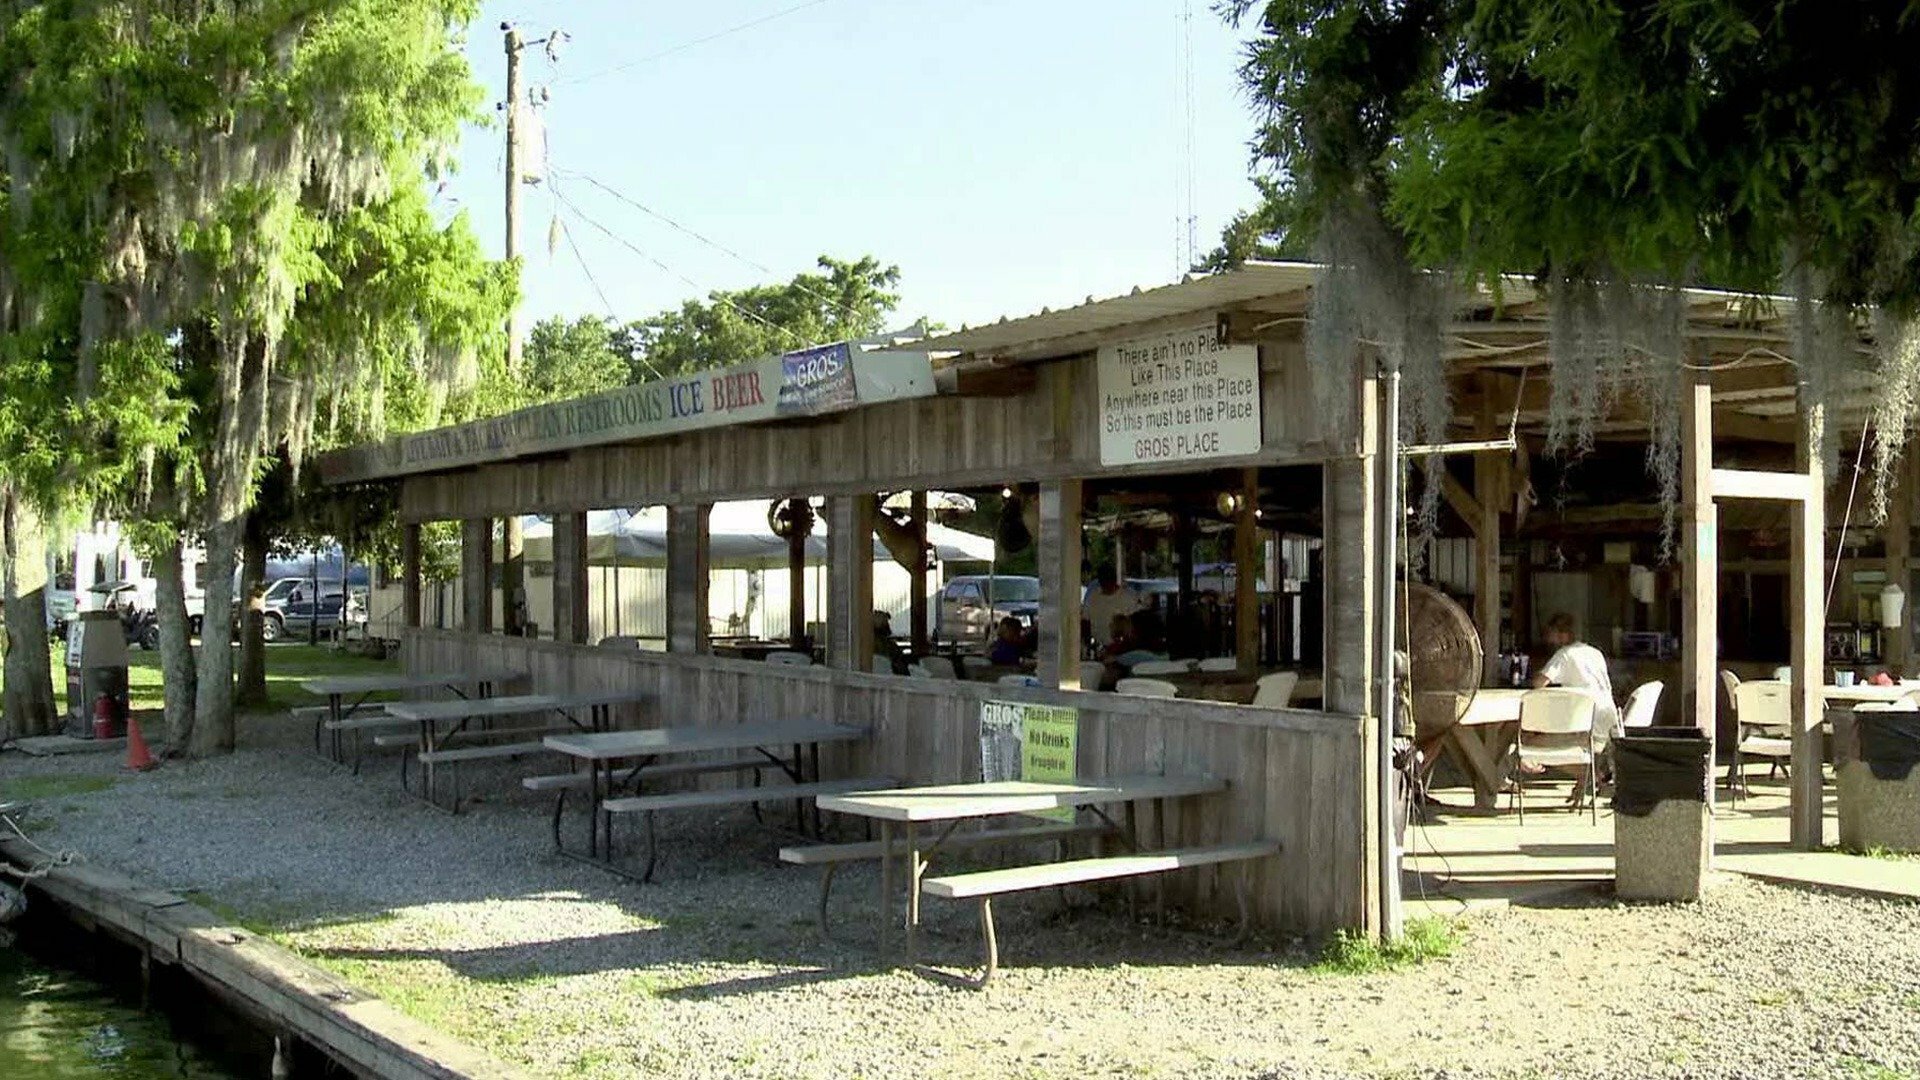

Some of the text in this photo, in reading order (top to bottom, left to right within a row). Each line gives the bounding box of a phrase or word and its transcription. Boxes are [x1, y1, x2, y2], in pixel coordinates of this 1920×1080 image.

[1117, 335, 1230, 365] There ain't no Pla
[1131, 359, 1218, 387] Like This Place
[566, 387, 663, 435] RESTROOMS
[669, 381, 704, 418] ICE
[712, 371, 764, 412] BEER
[1106, 378, 1253, 414] Anywhere near this Place
[1107, 401, 1253, 433] So this must be the Place
[1177, 432, 1219, 455] PLACE
[1023, 706, 1051, 723] Please
[1029, 729, 1070, 748] No Drinks
